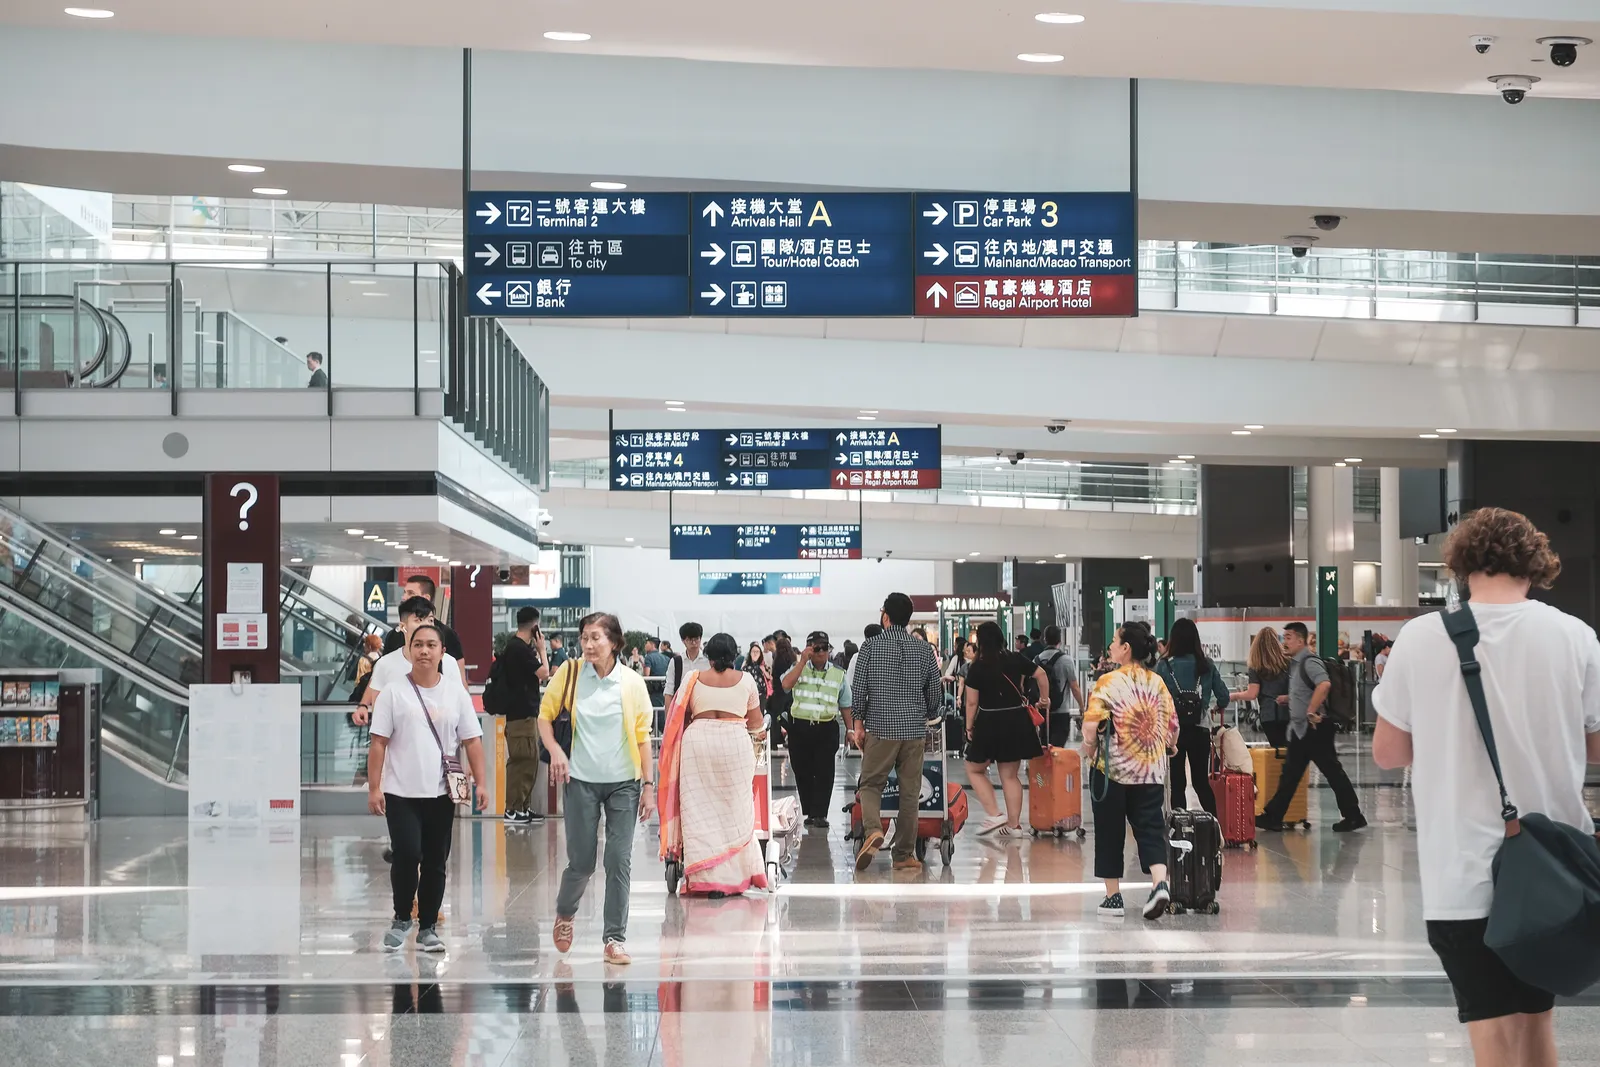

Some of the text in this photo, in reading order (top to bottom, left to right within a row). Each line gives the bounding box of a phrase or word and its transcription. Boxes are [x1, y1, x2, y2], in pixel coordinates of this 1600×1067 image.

[509, 206, 530, 221] T2
[536, 198, 646, 215] 二號客運大樓
[731, 198, 803, 215] 接機大堂
[807, 200, 832, 227] A
[983, 198, 1036, 215] 停車場
[1041, 201, 1058, 227] 3
[536, 216, 598, 227] Terminal 2
[731, 216, 801, 227] Arrivals Hall
[983, 216, 1032, 228] Car Park
[568, 239, 623, 256] 往市區
[761, 239, 871, 255] 團隊/酒店巴士
[568, 257, 607, 271] To city
[761, 256, 860, 268] Tour/Hotel Coach
[984, 256, 1131, 270] Mainland/Macao Transport
[536, 279, 572, 296] 銀行
[984, 278, 1092, 296] 富豪機場酒店
[536, 296, 565, 308] Bank
[984, 296, 1092, 310] Regal Airport Hotel
[632, 436, 642, 445] T1
[741, 436, 752, 444] T2
[887, 431, 900, 446] A
[673, 453, 684, 467] 4
[779, 460, 790, 468] city
[692, 480, 719, 488] Transport
[881, 479, 902, 487] Airport
[704, 526, 712, 536] A
[770, 526, 777, 536] 4
[367, 584, 385, 604] A
